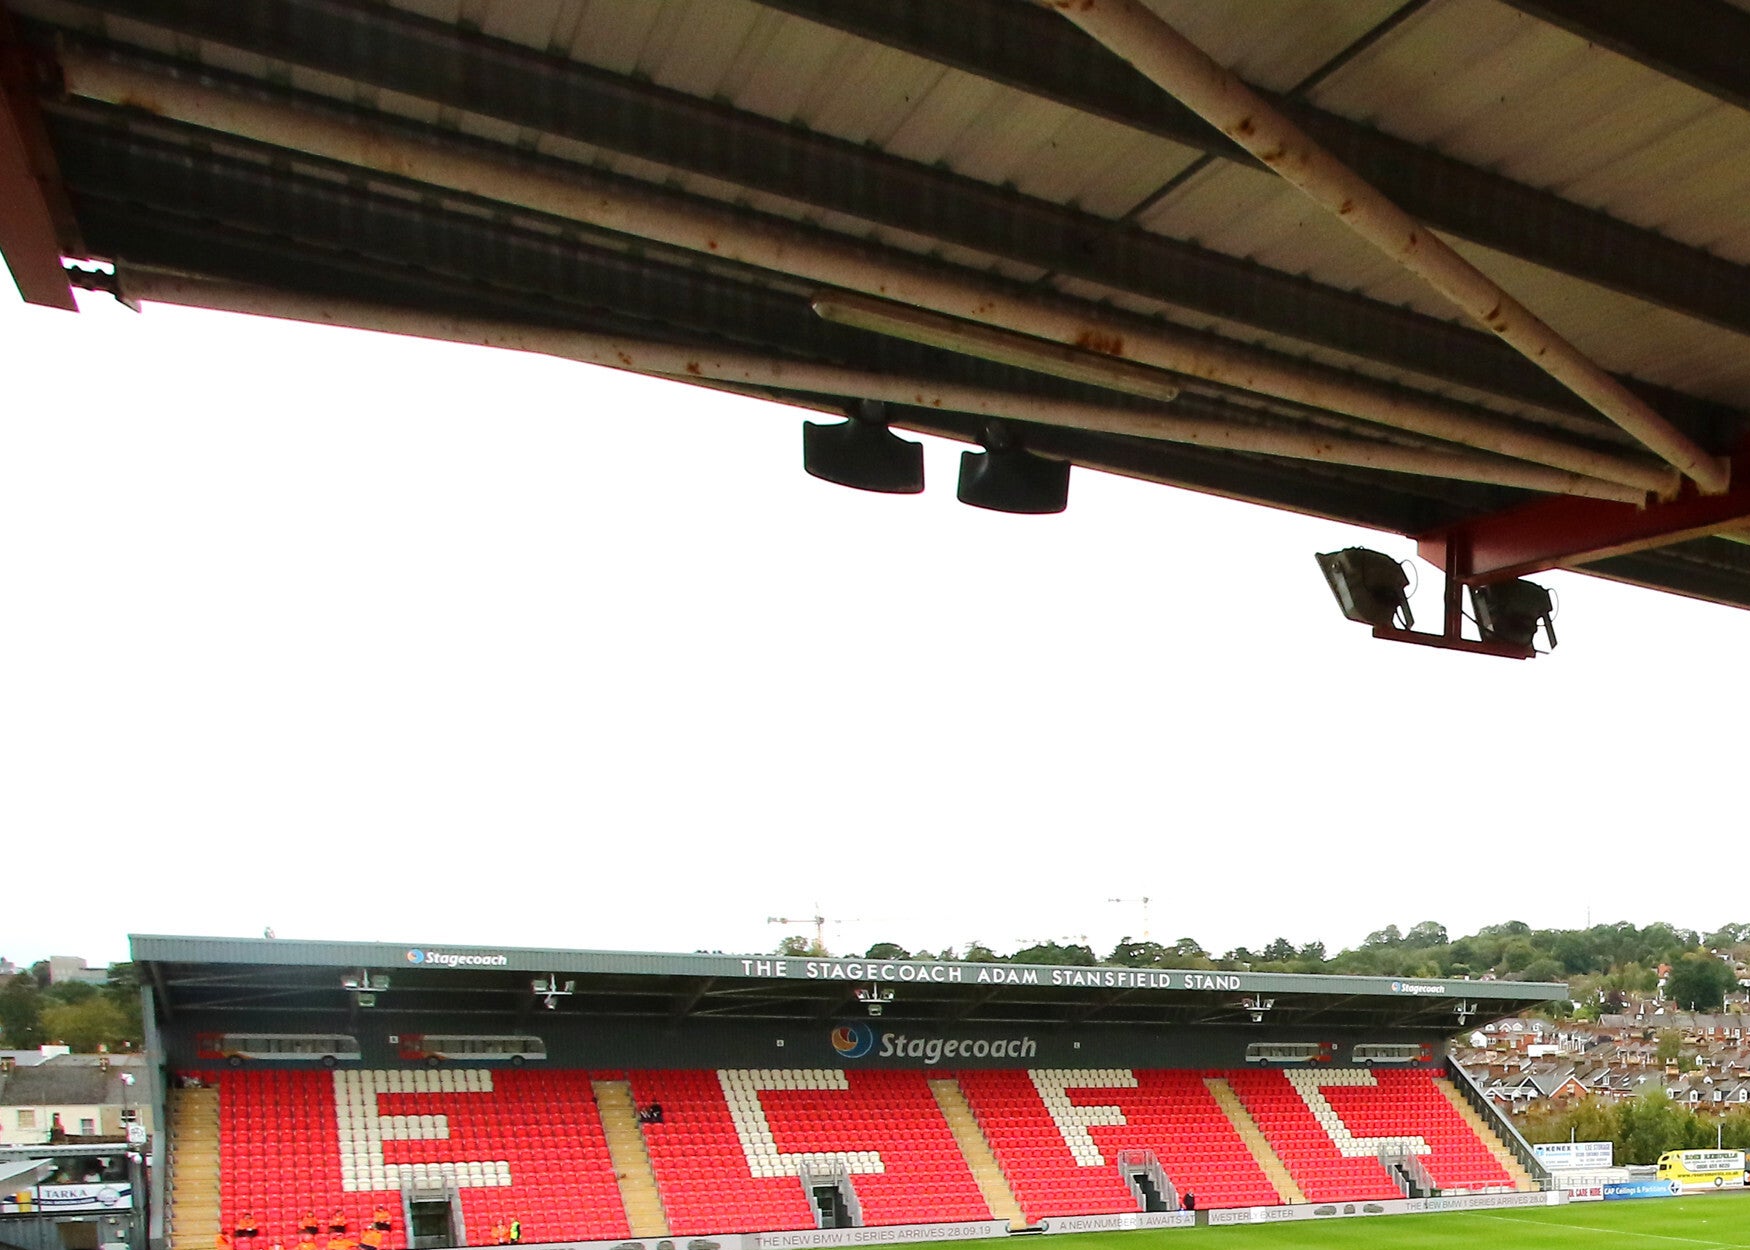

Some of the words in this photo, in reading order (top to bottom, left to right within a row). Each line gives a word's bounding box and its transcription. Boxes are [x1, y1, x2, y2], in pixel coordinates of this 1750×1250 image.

[425, 952, 507, 966] Stagecoach
[742, 960, 788, 977] THE
[807, 962, 962, 983] STAGECOACH
[977, 967, 1039, 985] ADAM
[1052, 969, 1171, 988] STANSFIELD
[1184, 975, 1241, 990] STAND
[1401, 983, 1445, 994] Stagecoach
[879, 1032, 1037, 1064] Stagecoach
[45, 1190, 88, 1198] TARKA
[1406, 1202, 1422, 1211] THE
[1443, 1199, 1462, 1209] BMW
[1469, 1198, 1496, 1207] SERIES
[1497, 1196, 1529, 1206] ARRIVES
[1059, 1221, 1068, 1230] A
[1069, 1220, 1092, 1230] NEW
[1093, 1218, 1136, 1229] NUMBER
[1146, 1216, 1179, 1227] AWAITS
[1182, 1214, 1196, 1224] AT
[1211, 1210, 1259, 1223] WESTERLY
[1261, 1209, 1294, 1220] EXETER
[755, 1236, 781, 1247] THE
[783, 1234, 810, 1246] NEW
[812, 1233, 842, 1245] BMW
[846, 1233, 851, 1242] 1
[854, 1231, 895, 1243] SERIES
[899, 1228, 944, 1240] ARRIVES
[947, 1225, 991, 1237] 28.09.19
